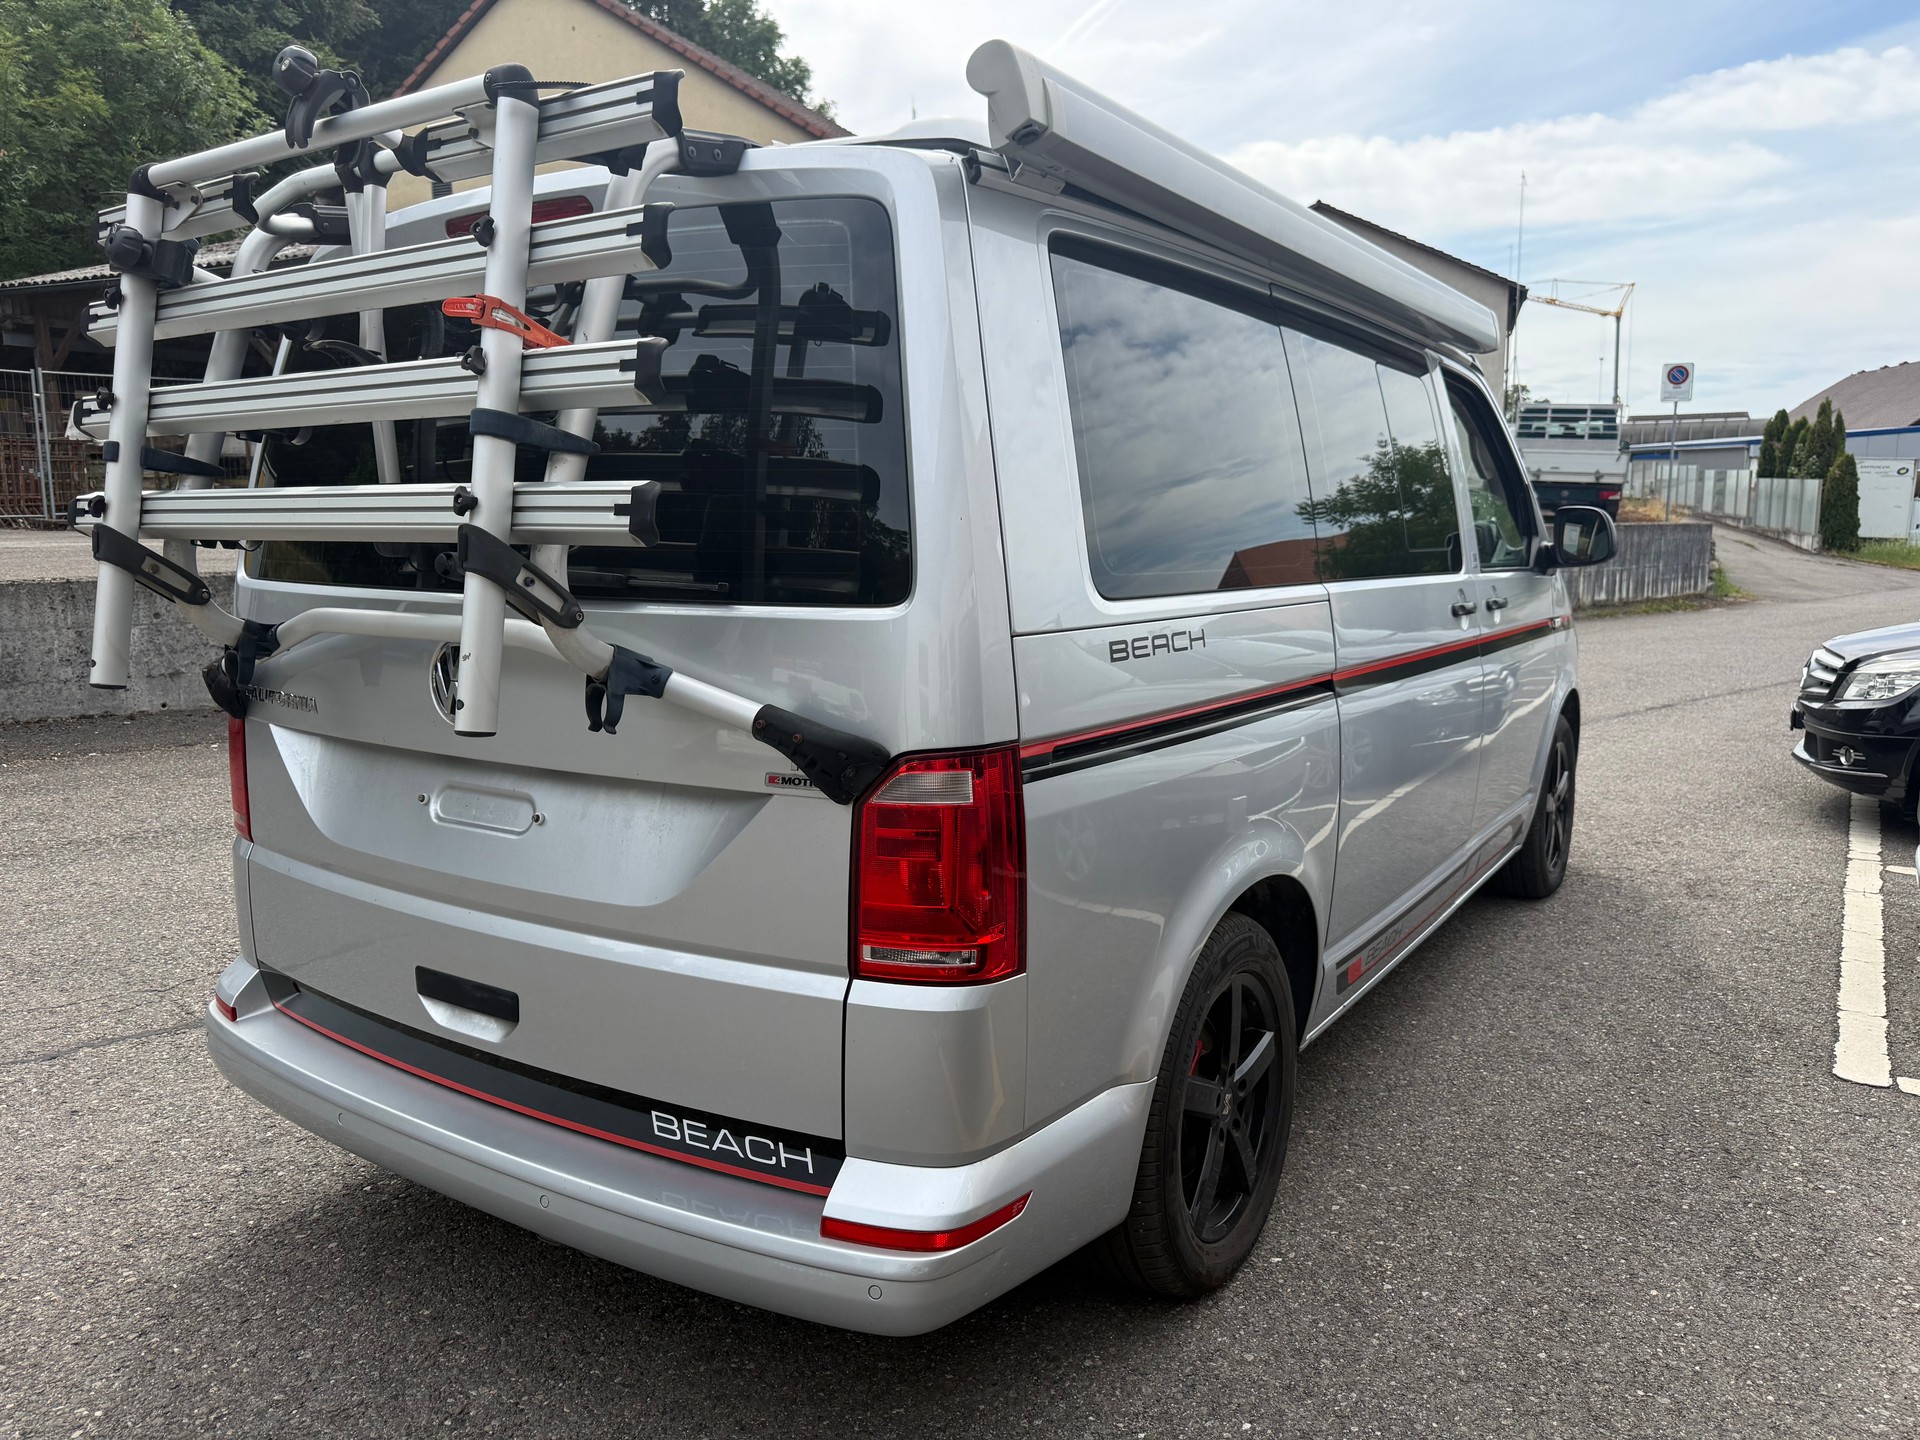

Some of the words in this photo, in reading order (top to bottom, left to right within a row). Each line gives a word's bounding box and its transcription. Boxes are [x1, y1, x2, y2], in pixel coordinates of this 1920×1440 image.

[1109, 629, 1205, 663] BEACH
[769, 775, 816, 787] 4MOTI
[651, 1110, 813, 1174] BEACH
